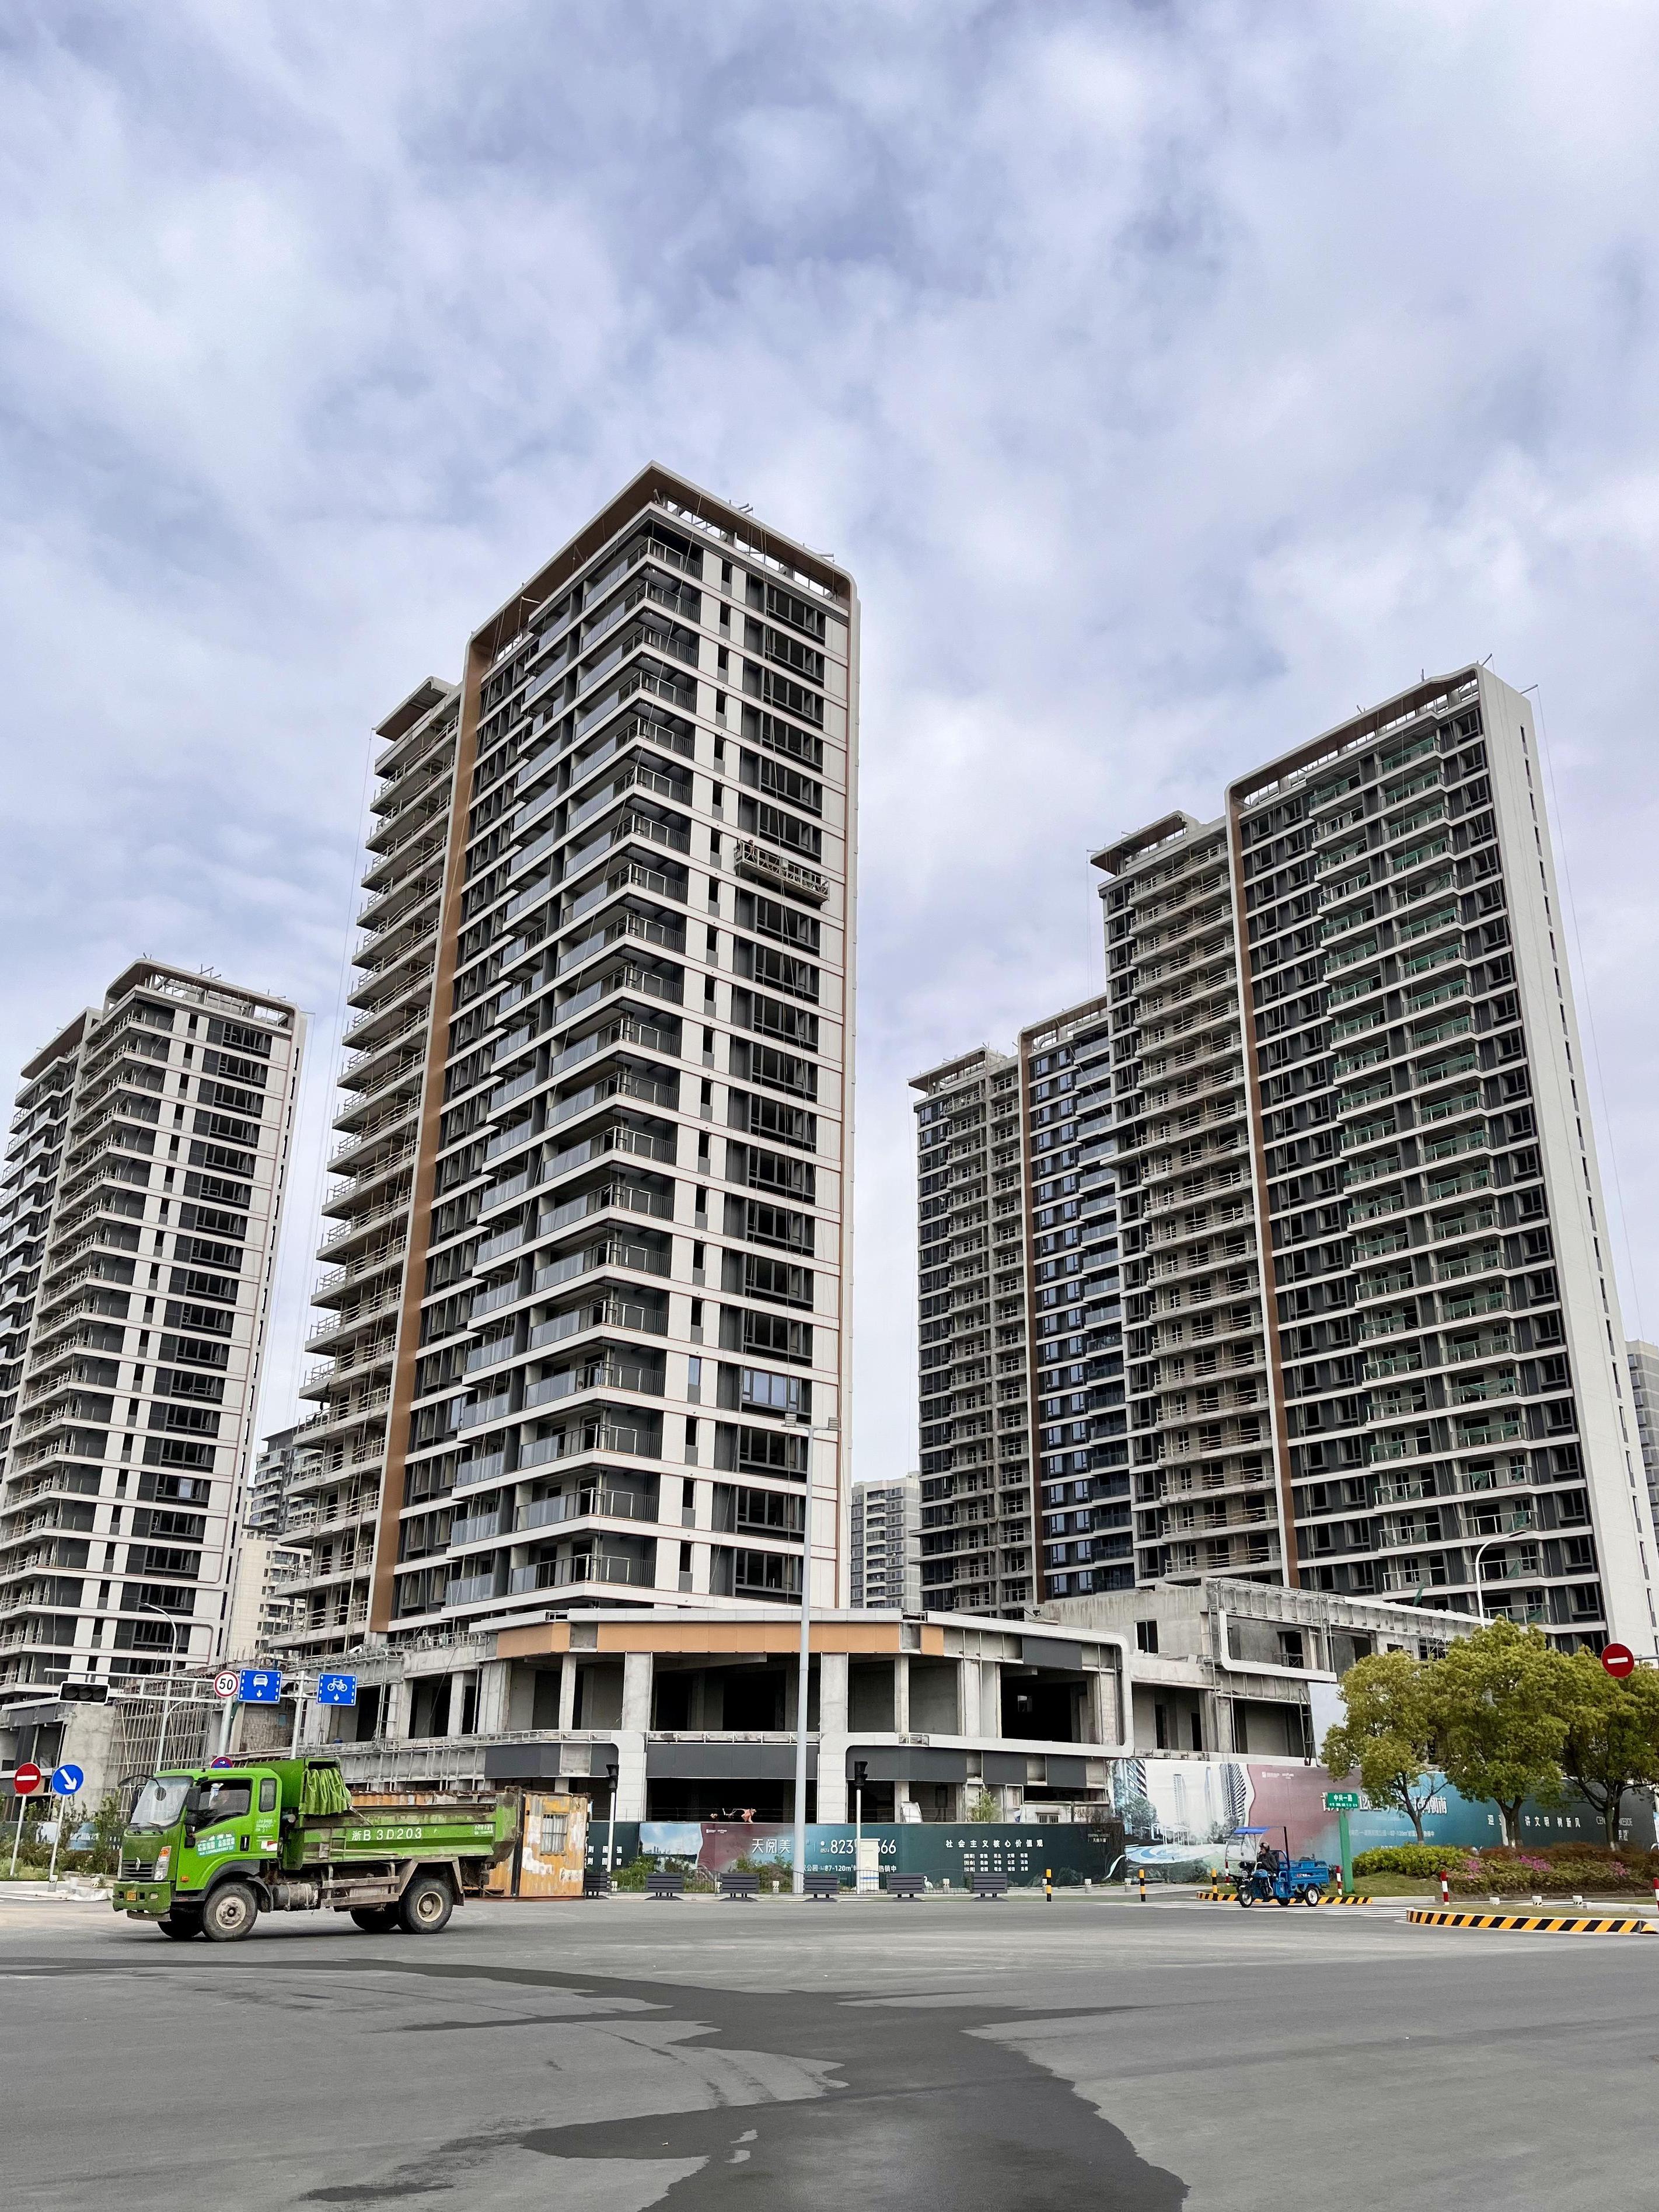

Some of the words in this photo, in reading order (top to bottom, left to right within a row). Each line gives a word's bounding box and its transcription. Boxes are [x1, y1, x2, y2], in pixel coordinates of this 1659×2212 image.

[219, 1678, 233, 1690] 50
[376, 1827, 422, 1840] 3D203
[752, 1838, 791, 1854] 天阅美
[945, 1839, 1043, 1848] 社会主义核心价值观
